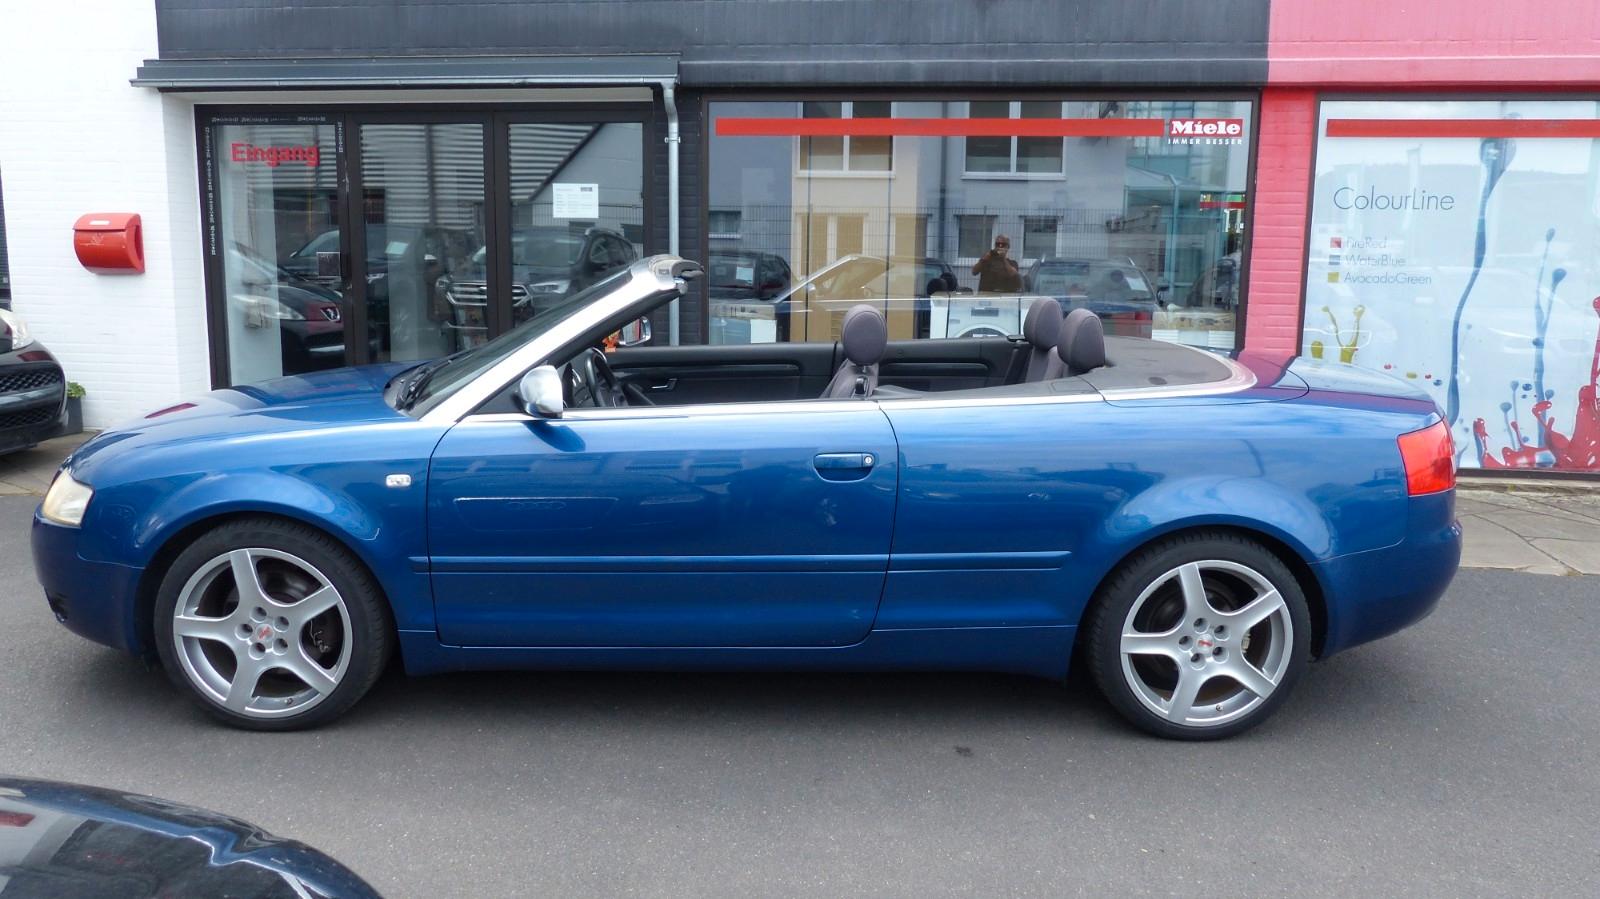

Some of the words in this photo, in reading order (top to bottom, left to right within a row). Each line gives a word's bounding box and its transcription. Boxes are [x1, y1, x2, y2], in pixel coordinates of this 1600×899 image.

[1171, 120, 1241, 135] Miele
[231, 143, 320, 167] Eingang
[1333, 185, 1455, 210] ColourLine
[1345, 254, 1406, 266] WaterBlue
[1344, 271, 1432, 284] AvocadoGreen
